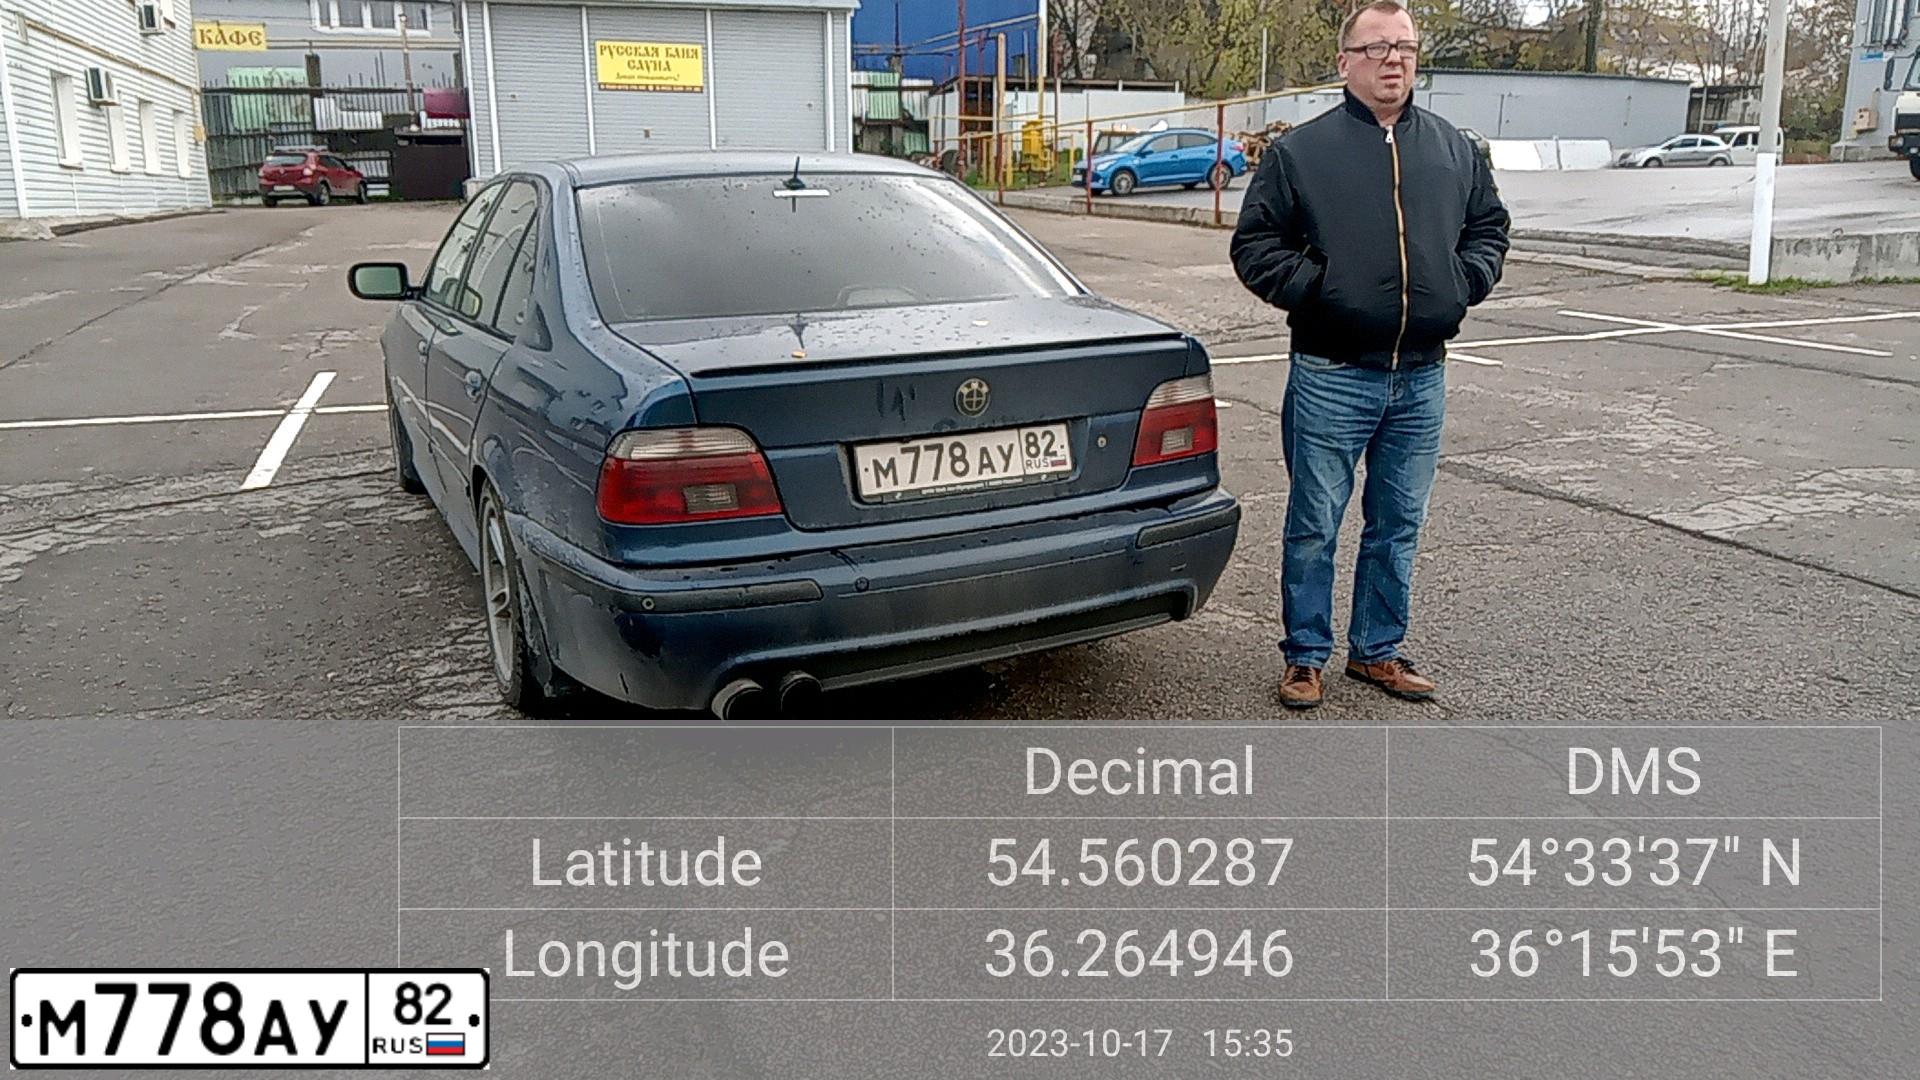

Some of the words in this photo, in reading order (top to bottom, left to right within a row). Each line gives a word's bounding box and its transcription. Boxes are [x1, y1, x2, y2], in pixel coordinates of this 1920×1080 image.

[199, 27, 263, 46] КАФЕ
[599, 44, 660, 59] РУССКАЯ
[665, 47, 699, 59] БАНЯ
[627, 59, 672, 74] САУНА
[872, 441, 1014, 488] М778АУ
[1024, 430, 1057, 458] 82
[1025, 458, 1050, 470] RUS
